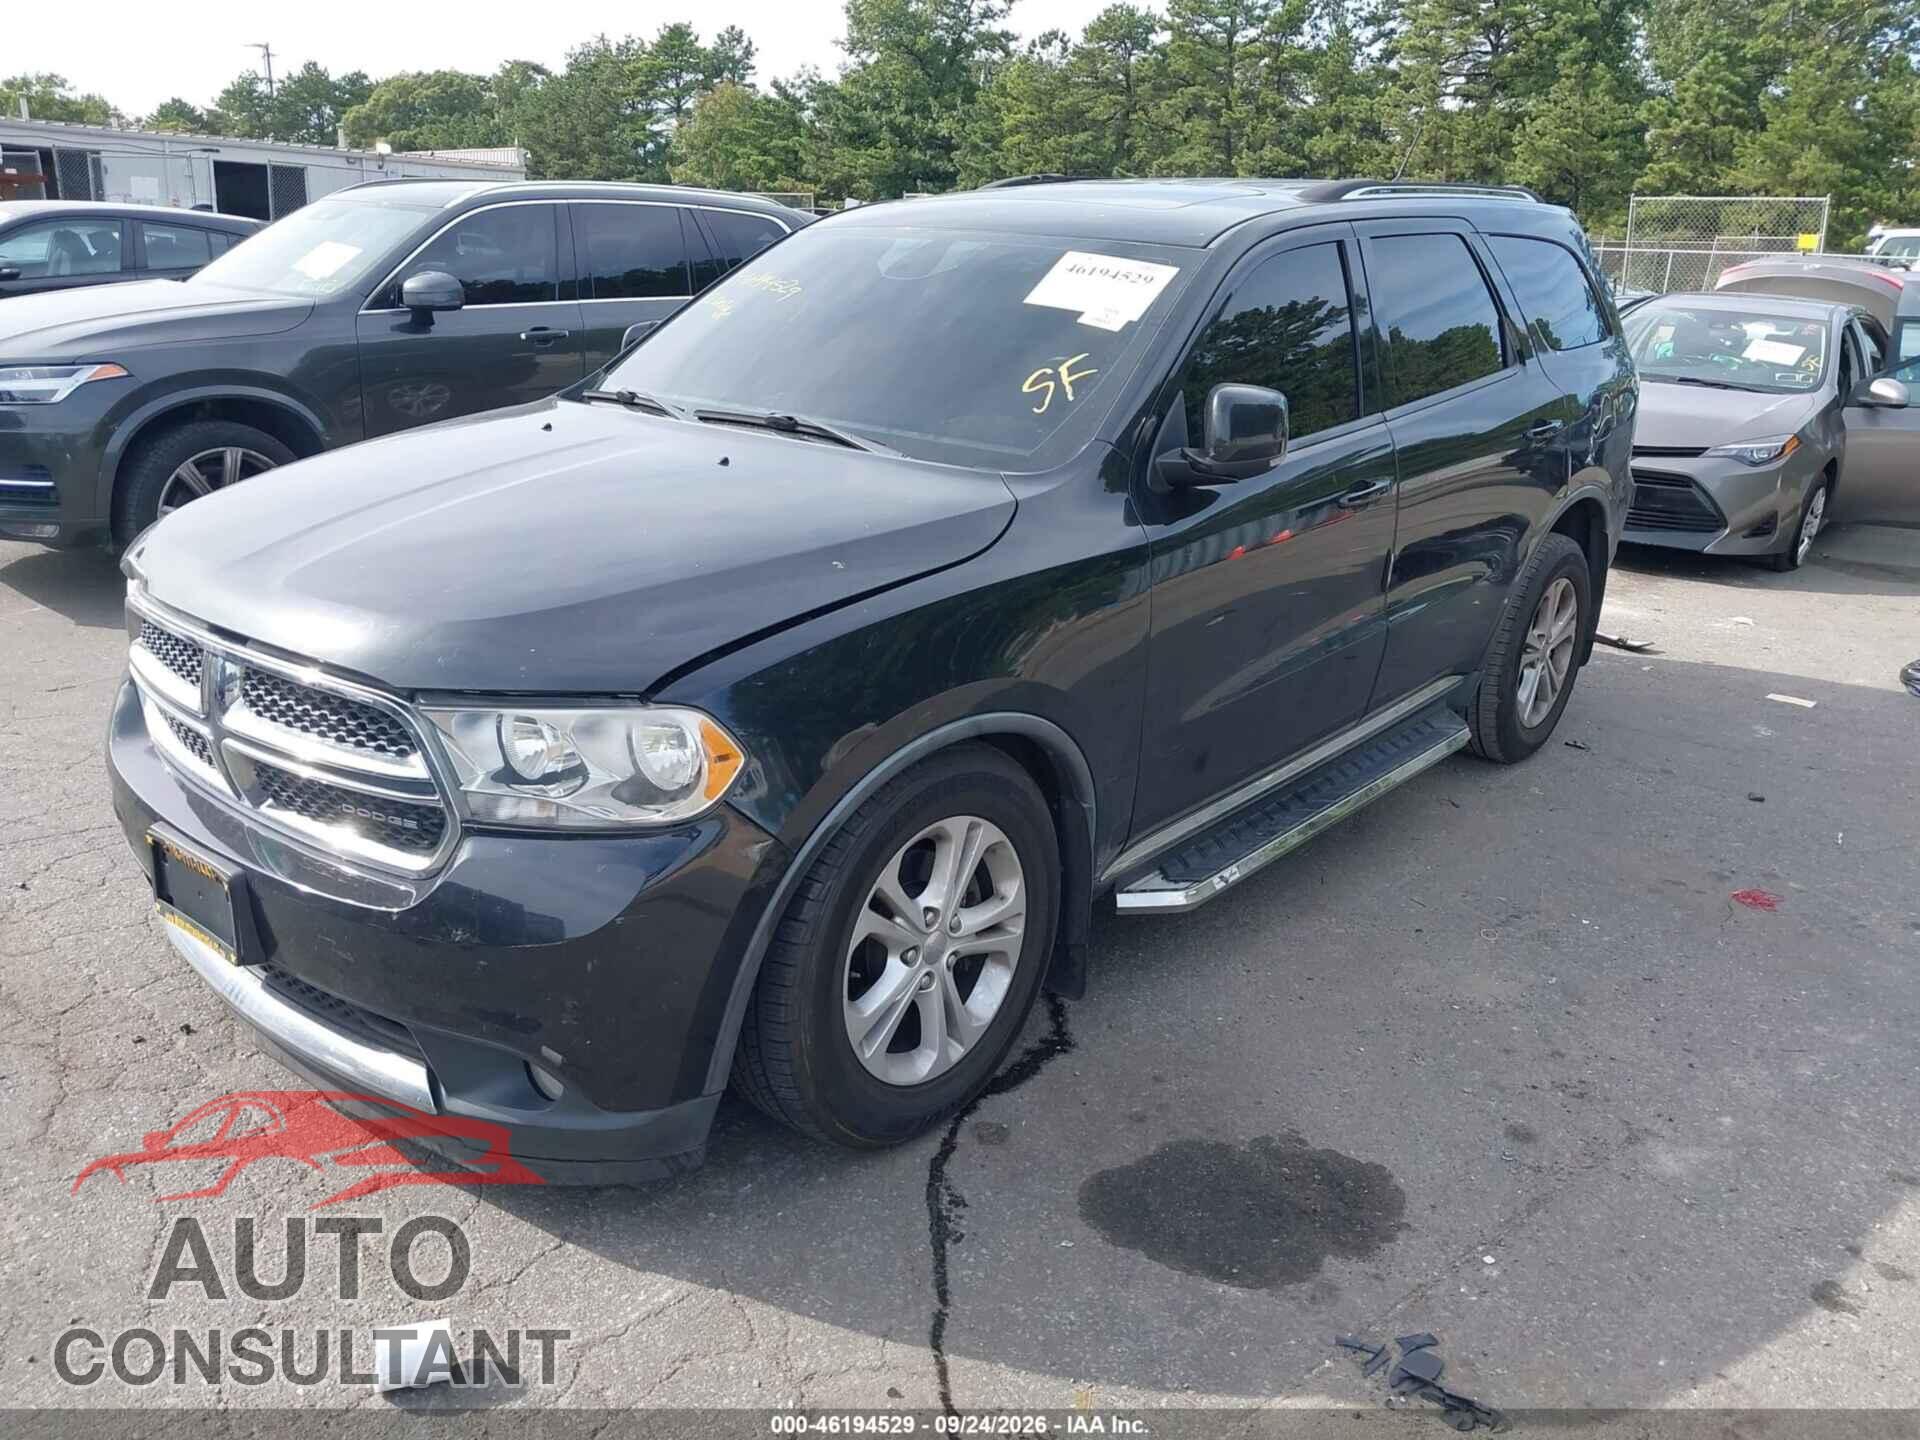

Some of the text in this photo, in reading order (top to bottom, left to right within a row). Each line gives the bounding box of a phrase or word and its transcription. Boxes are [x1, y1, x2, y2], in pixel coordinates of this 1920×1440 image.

[1065, 262, 1155, 285] 46194529
[1021, 352, 1099, 414] SF
[342, 803, 418, 829] DODGE
